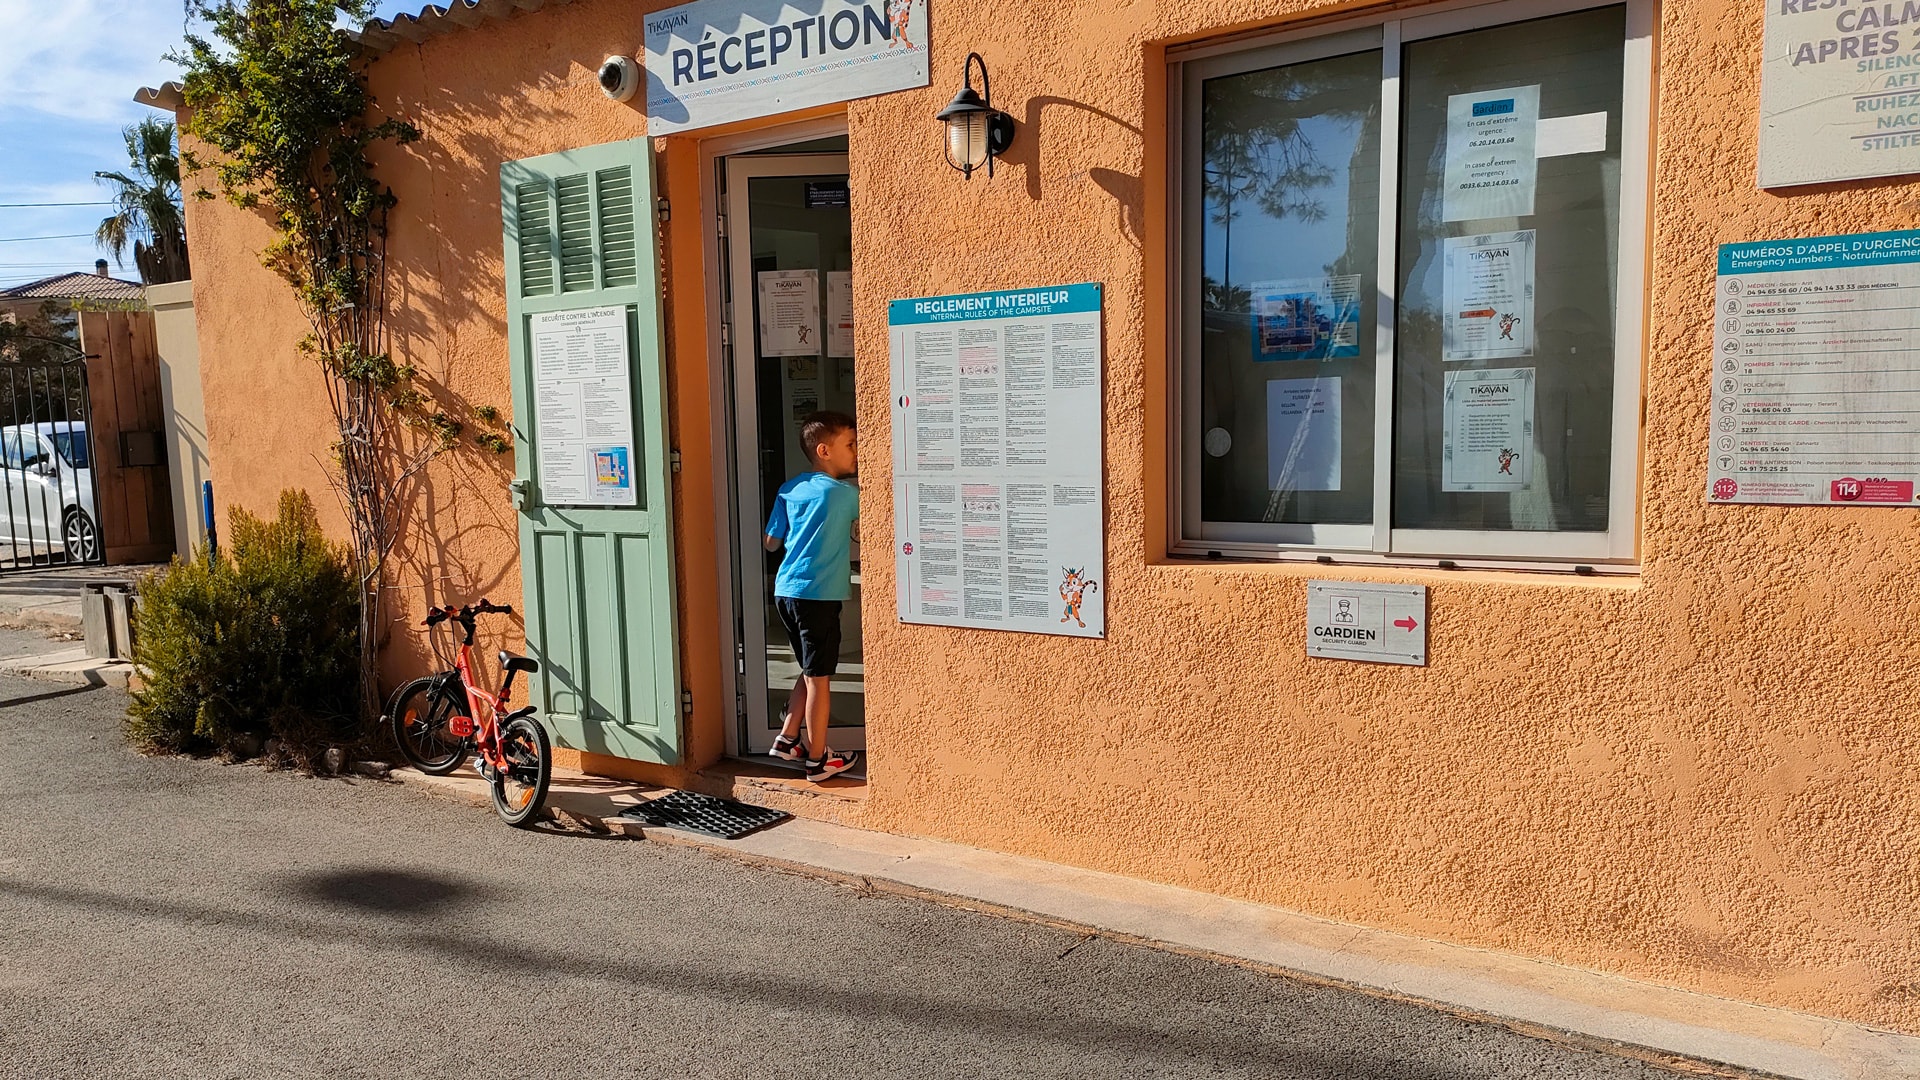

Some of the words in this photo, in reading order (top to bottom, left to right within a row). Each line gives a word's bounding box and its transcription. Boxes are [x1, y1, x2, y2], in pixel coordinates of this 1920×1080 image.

[673, 1, 892, 86] RÉCEPTION
[1792, 30, 1900, 67] APRES
[1884, 73, 1920, 89] AFT
[1473, 103, 1508, 115] Gardien
[1877, 113, 1920, 129] NAC
[1479, 128, 1503, 136] urgence
[1471, 170, 1505, 178] emergency
[1732, 245, 1793, 260] NUMÉROS
[1797, 243, 1848, 255] D'APPEL
[1732, 258, 1786, 269] Emergency
[1789, 254, 1833, 264] numbers
[915, 296, 994, 314] REGLEMENT
[996, 290, 1069, 308] INTERIEUR
[930, 312, 963, 320] INTERNAL
[965, 311, 987, 319] RULES
[1000, 308, 1014, 316] THE
[1015, 306, 1052, 314] CAMPSITE
[1716, 485, 1734, 493] 112
[1837, 483, 1858, 496] 114
[1314, 626, 1376, 641] GARDIEN
